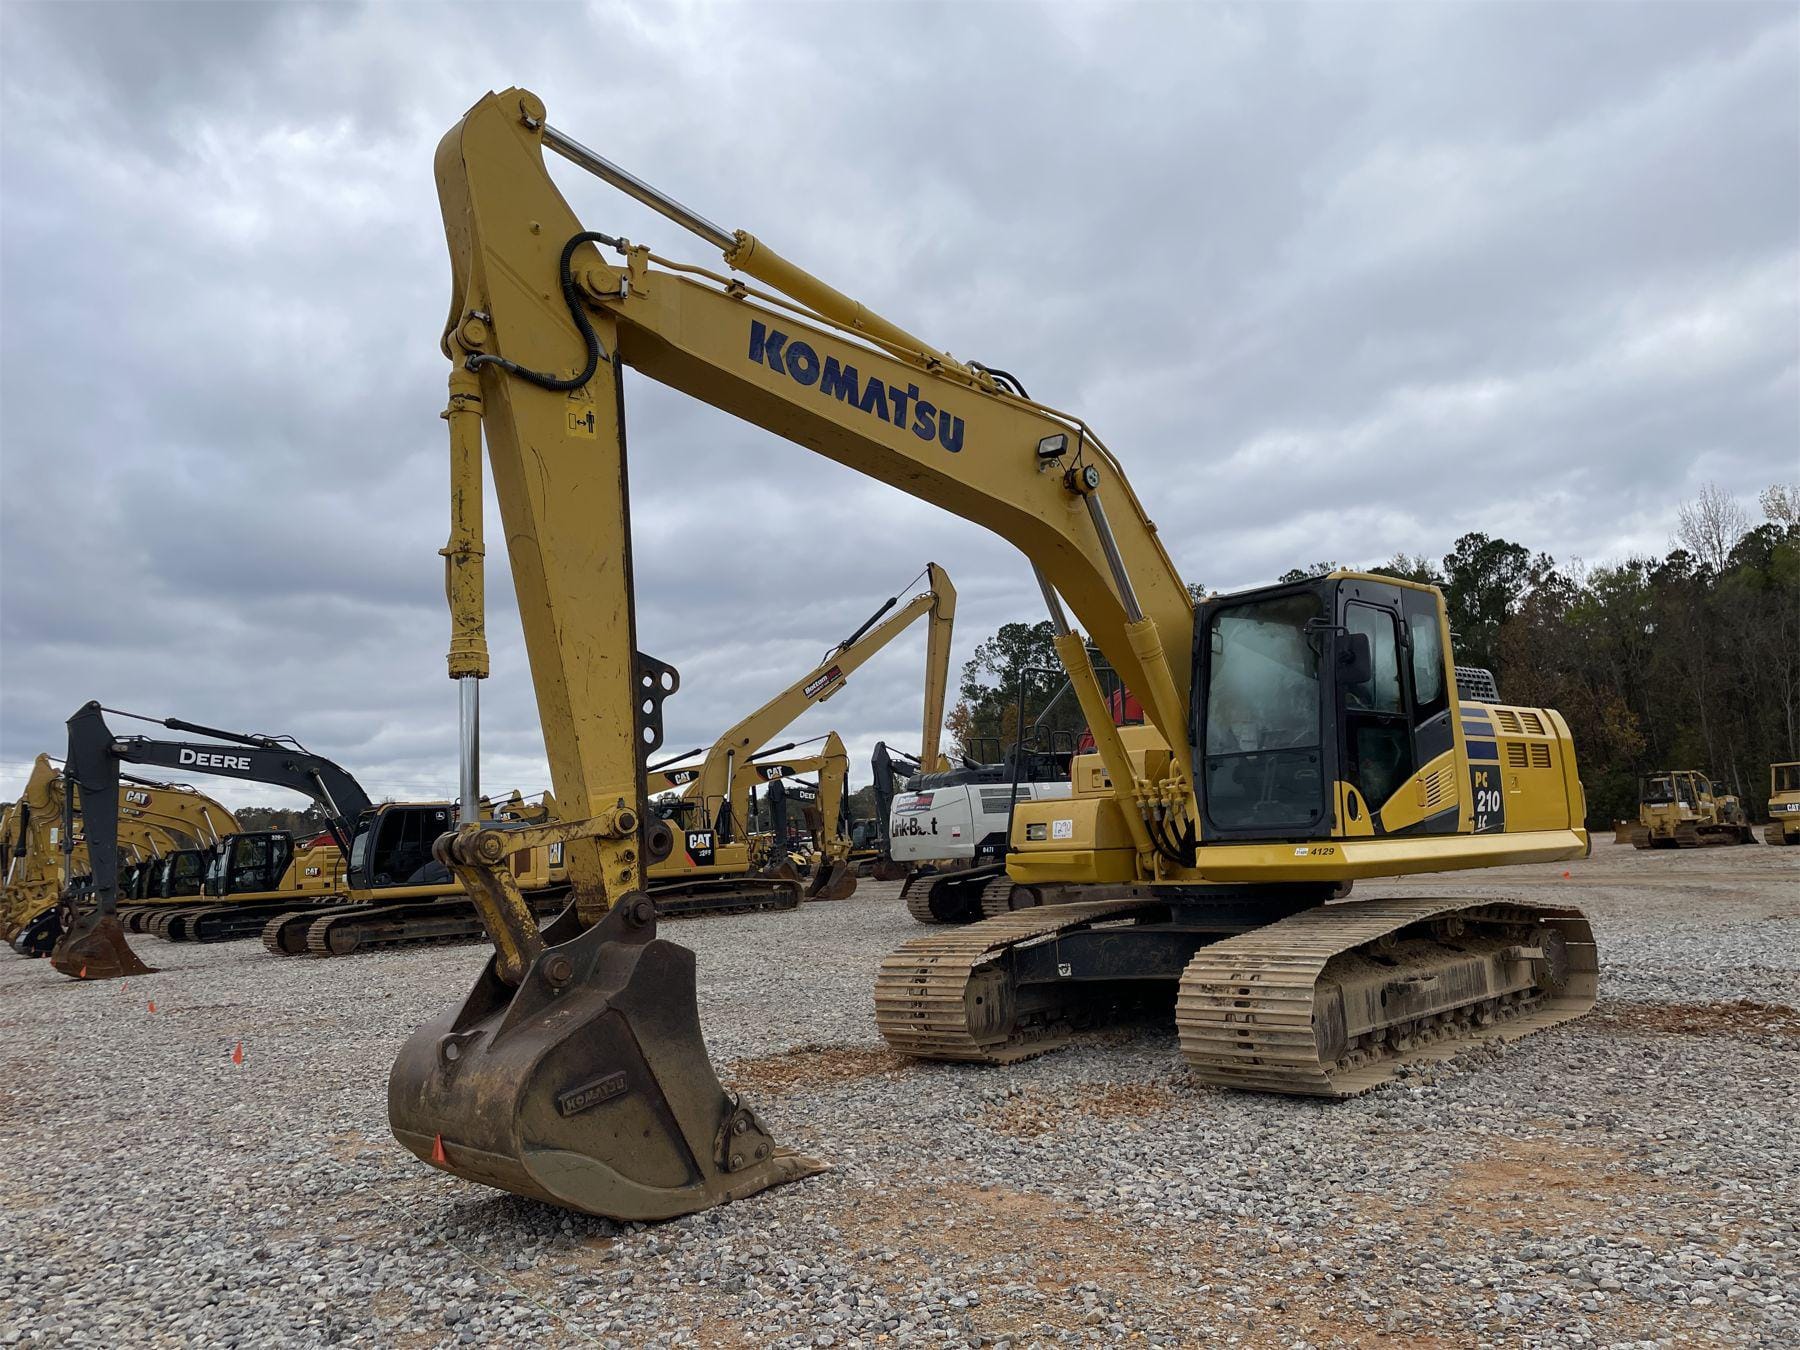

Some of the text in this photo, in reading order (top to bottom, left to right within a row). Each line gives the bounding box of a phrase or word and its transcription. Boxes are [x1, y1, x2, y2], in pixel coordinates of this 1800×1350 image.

[749, 319, 965, 453] KOMATSU
[179, 748, 251, 770] DEERE
[674, 771, 691, 785] CAT
[766, 766, 783, 779] CAT
[1475, 771, 1488, 788] PC
[126, 790, 148, 804] CAT
[1477, 790, 1500, 812] 210
[689, 833, 711, 849] CAT
[1311, 847, 1335, 856] 4129
[305, 867, 319, 876] CAT
